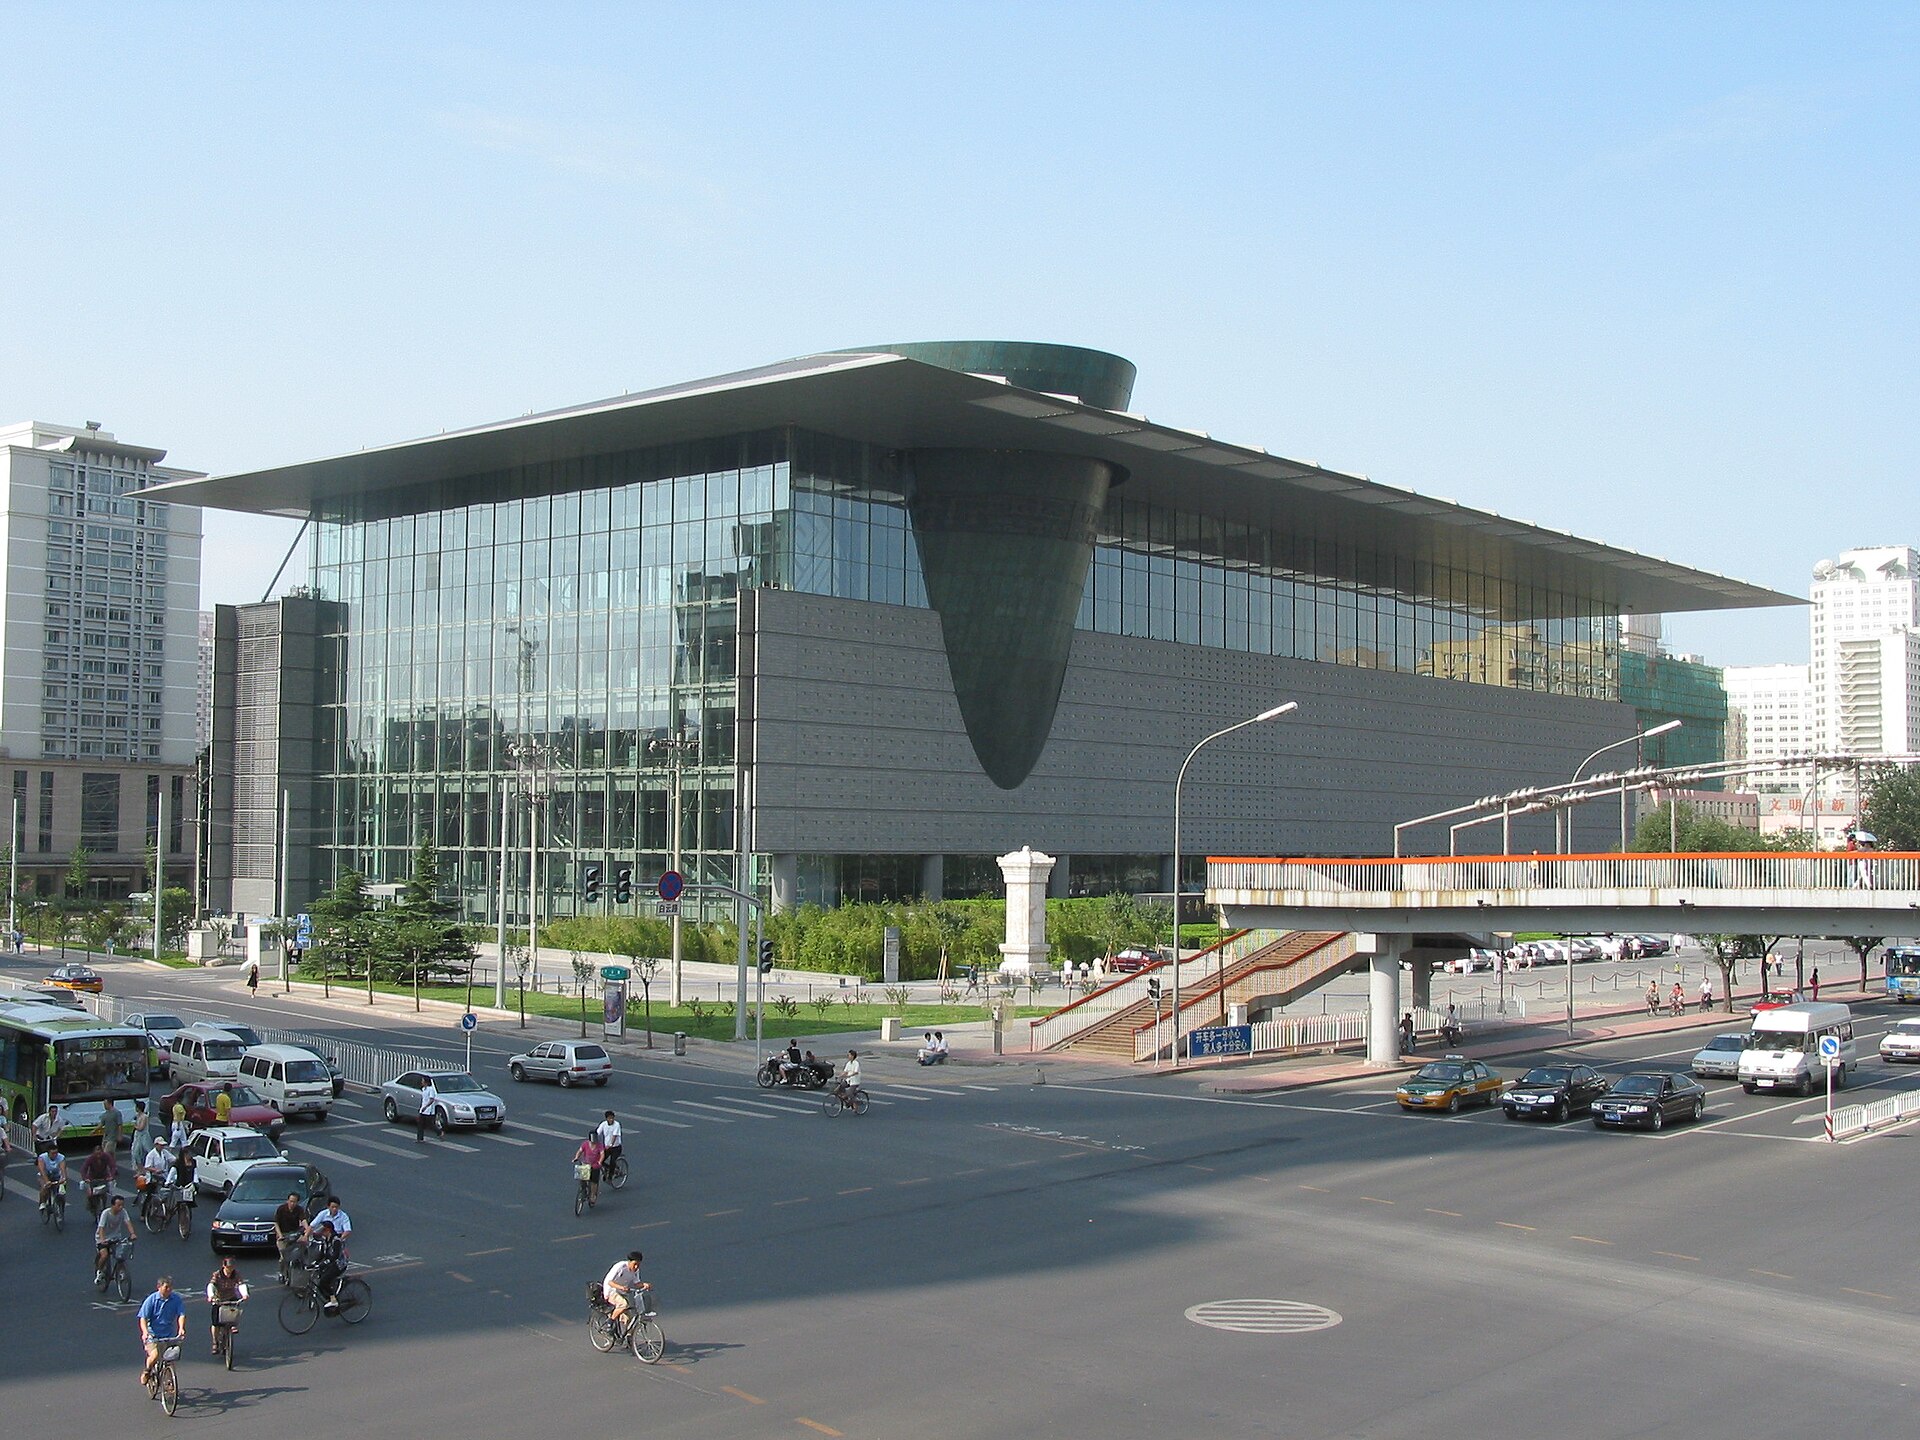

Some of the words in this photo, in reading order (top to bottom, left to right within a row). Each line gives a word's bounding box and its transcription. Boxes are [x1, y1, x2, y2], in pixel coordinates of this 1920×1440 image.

[1196, 1029, 1240, 1043] 开车多一分小心
[1203, 1039, 1247, 1053] 家人多十分安心
